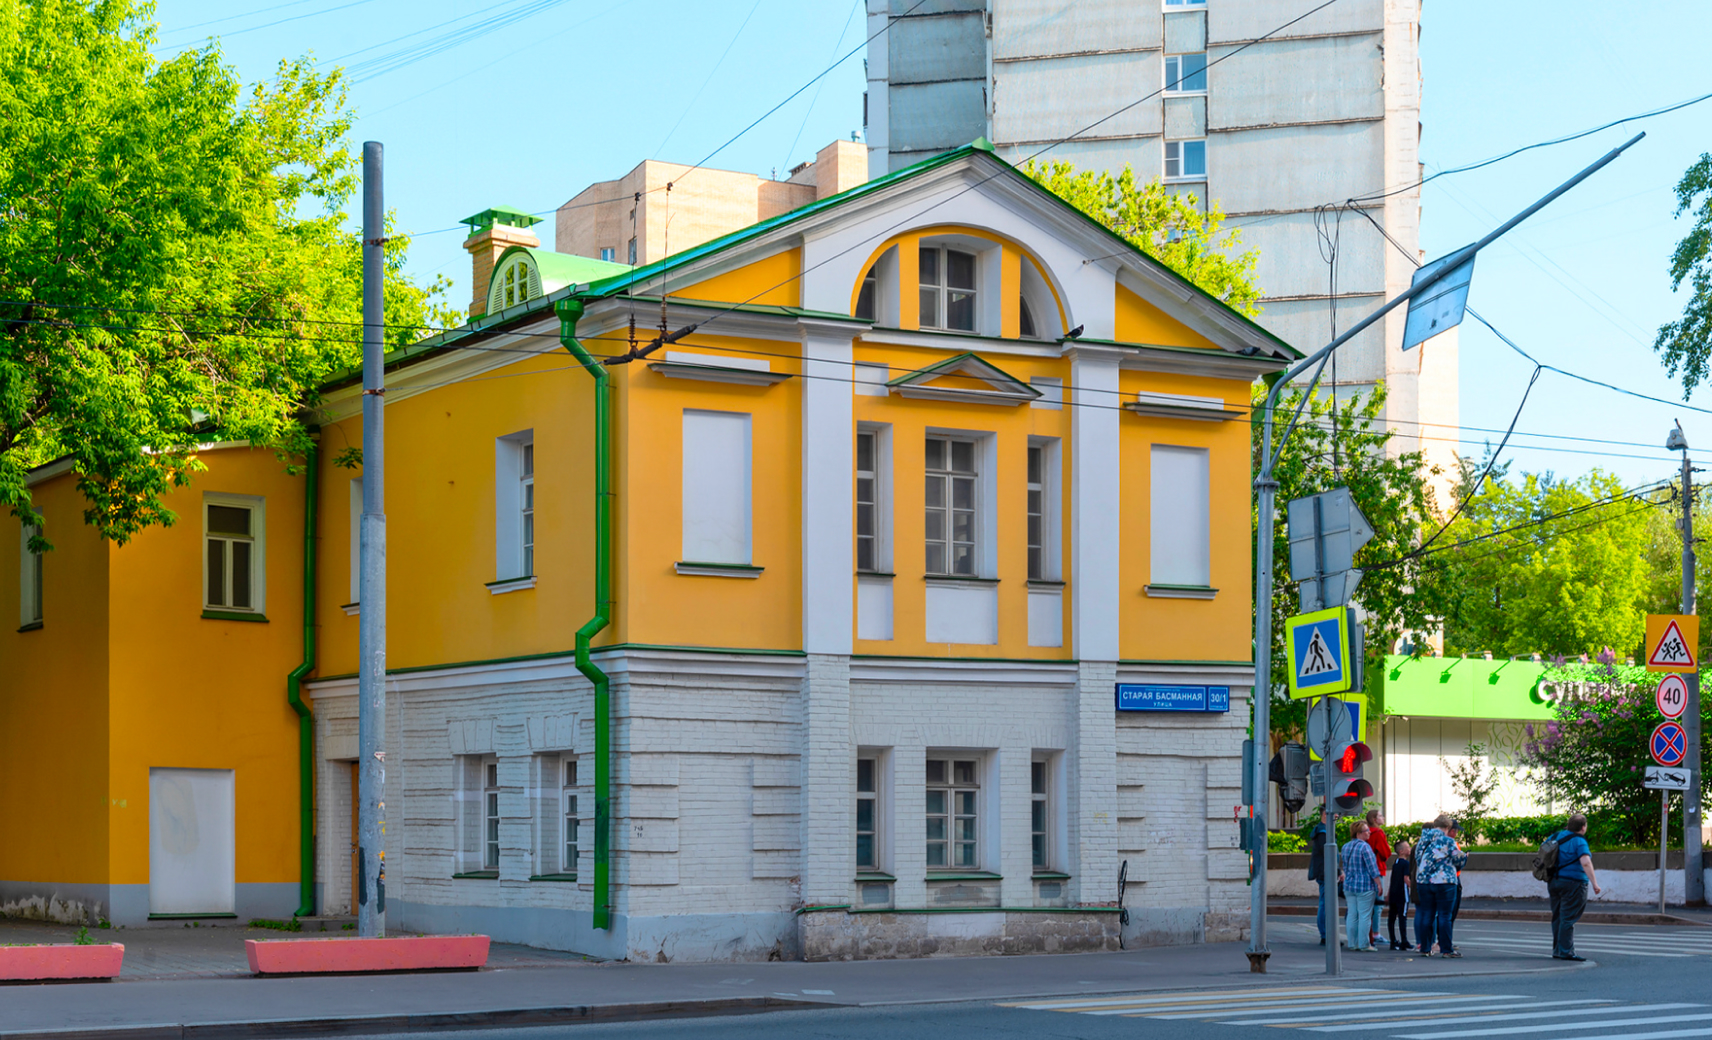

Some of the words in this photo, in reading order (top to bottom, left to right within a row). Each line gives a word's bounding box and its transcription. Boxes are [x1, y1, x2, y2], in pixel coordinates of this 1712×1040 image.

[1122, 691, 1153, 700] СТАРАЯ
[1155, 692, 1203, 701] БАСМАННАЯ
[1210, 693, 1226, 703] 30/1
[1663, 687, 1681, 705] 40
